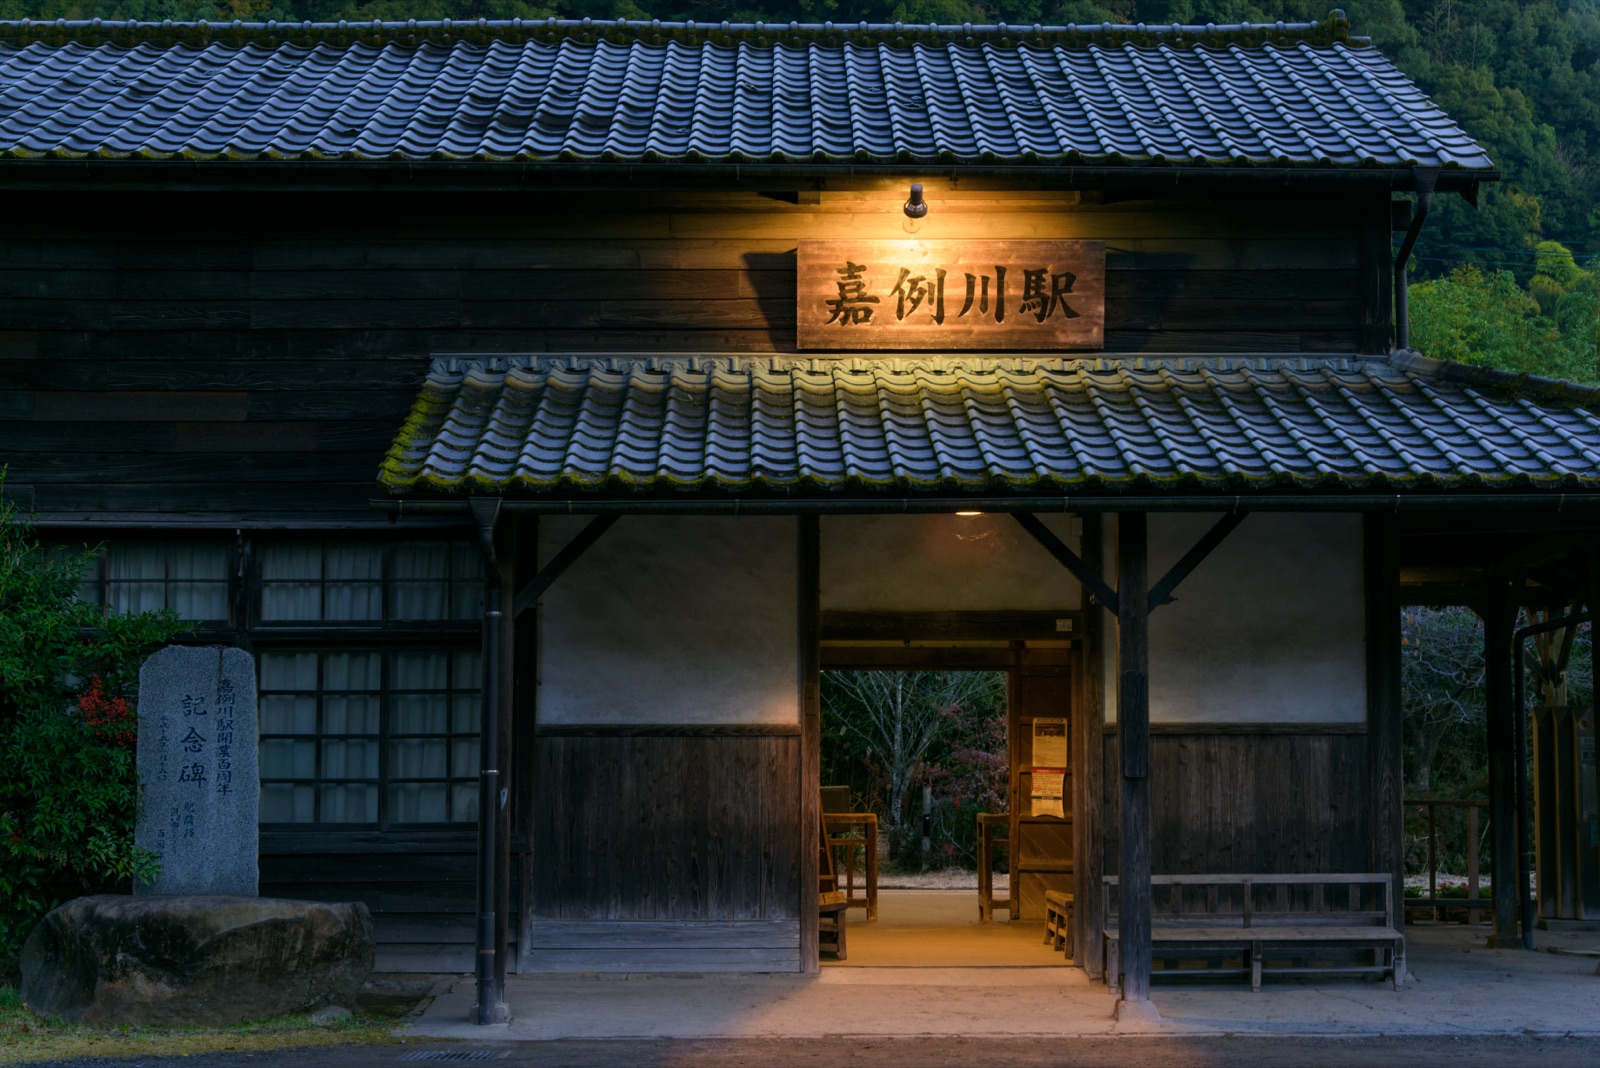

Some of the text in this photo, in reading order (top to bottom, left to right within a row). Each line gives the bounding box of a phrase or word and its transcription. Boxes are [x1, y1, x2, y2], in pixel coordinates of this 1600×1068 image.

[825, 261, 1081, 326] 嘉例川駅
[178, 695, 208, 790] 記念碑
[216, 678, 236, 796] 嘉例川駅開業百周年
